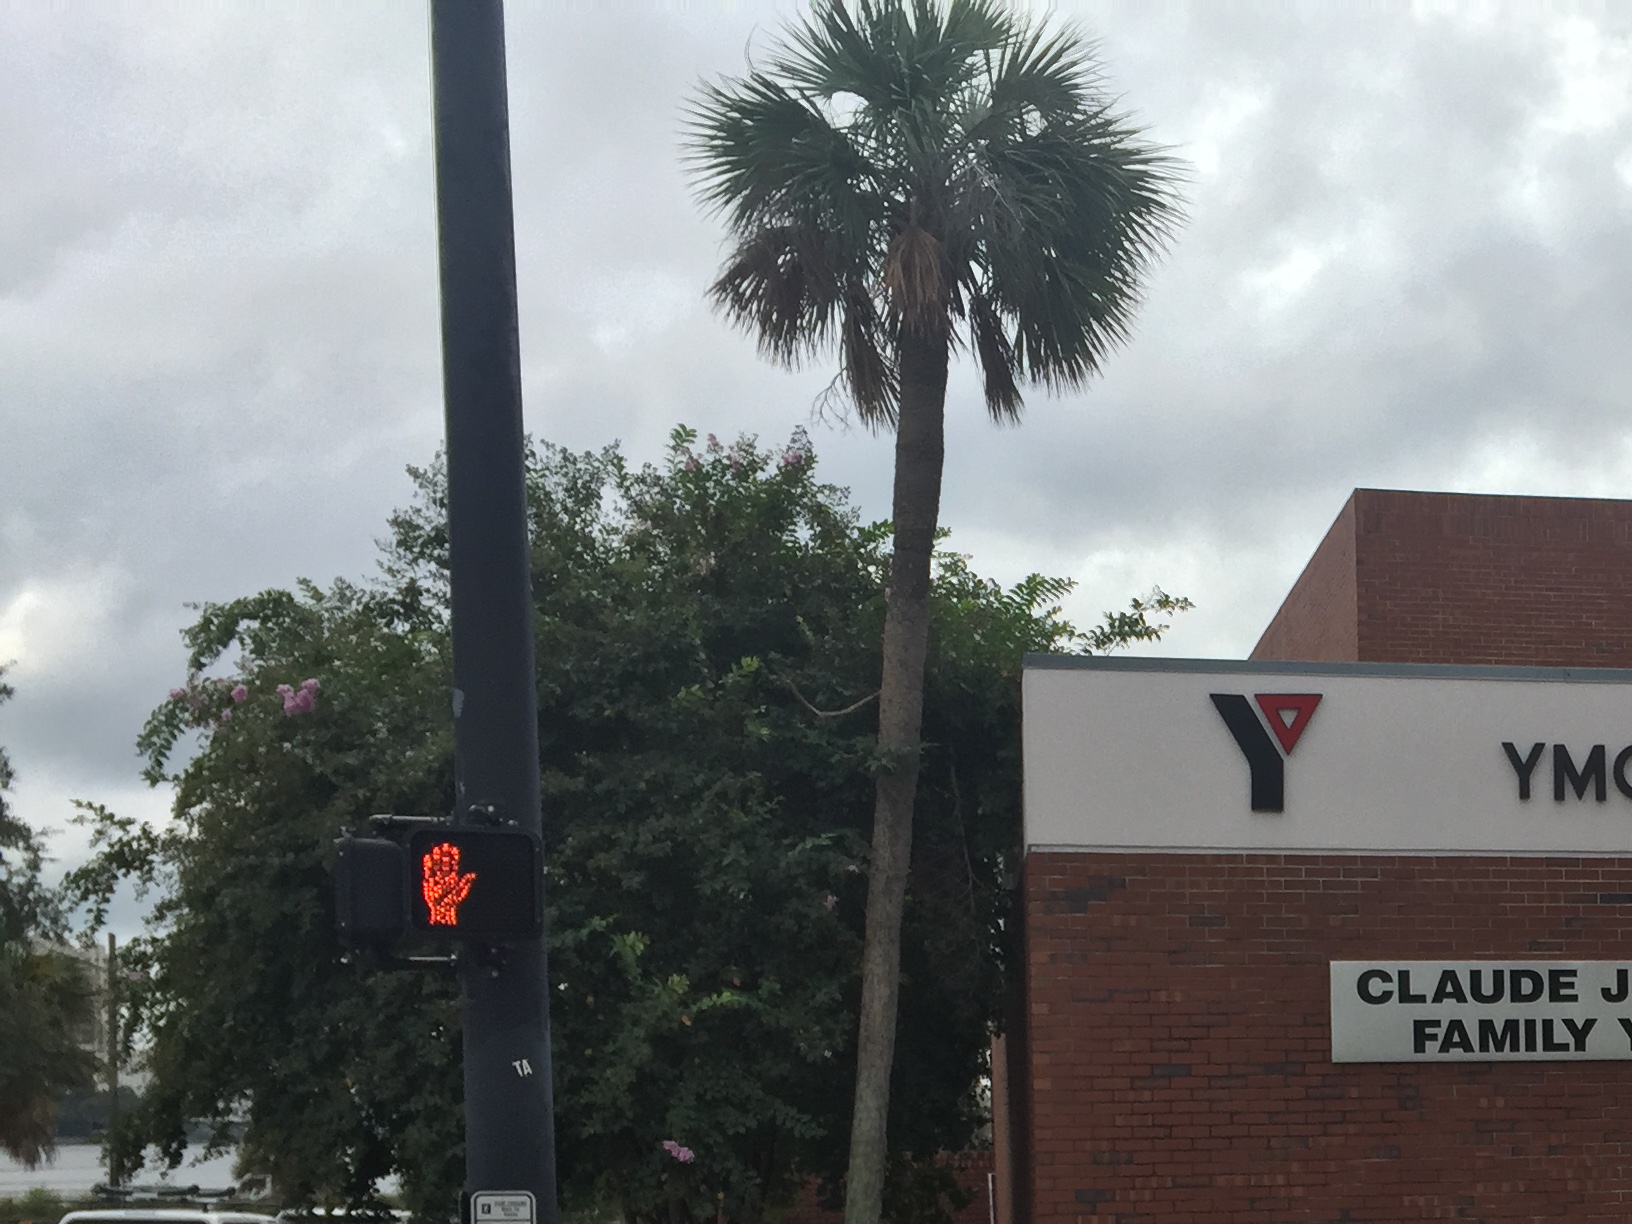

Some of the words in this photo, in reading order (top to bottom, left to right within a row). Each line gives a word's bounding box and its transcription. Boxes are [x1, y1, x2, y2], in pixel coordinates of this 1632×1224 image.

[1356, 968, 1579, 1005] CLAUDE
[1412, 1017, 1598, 1054] FAMILY
[511, 1058, 533, 1078] TA
